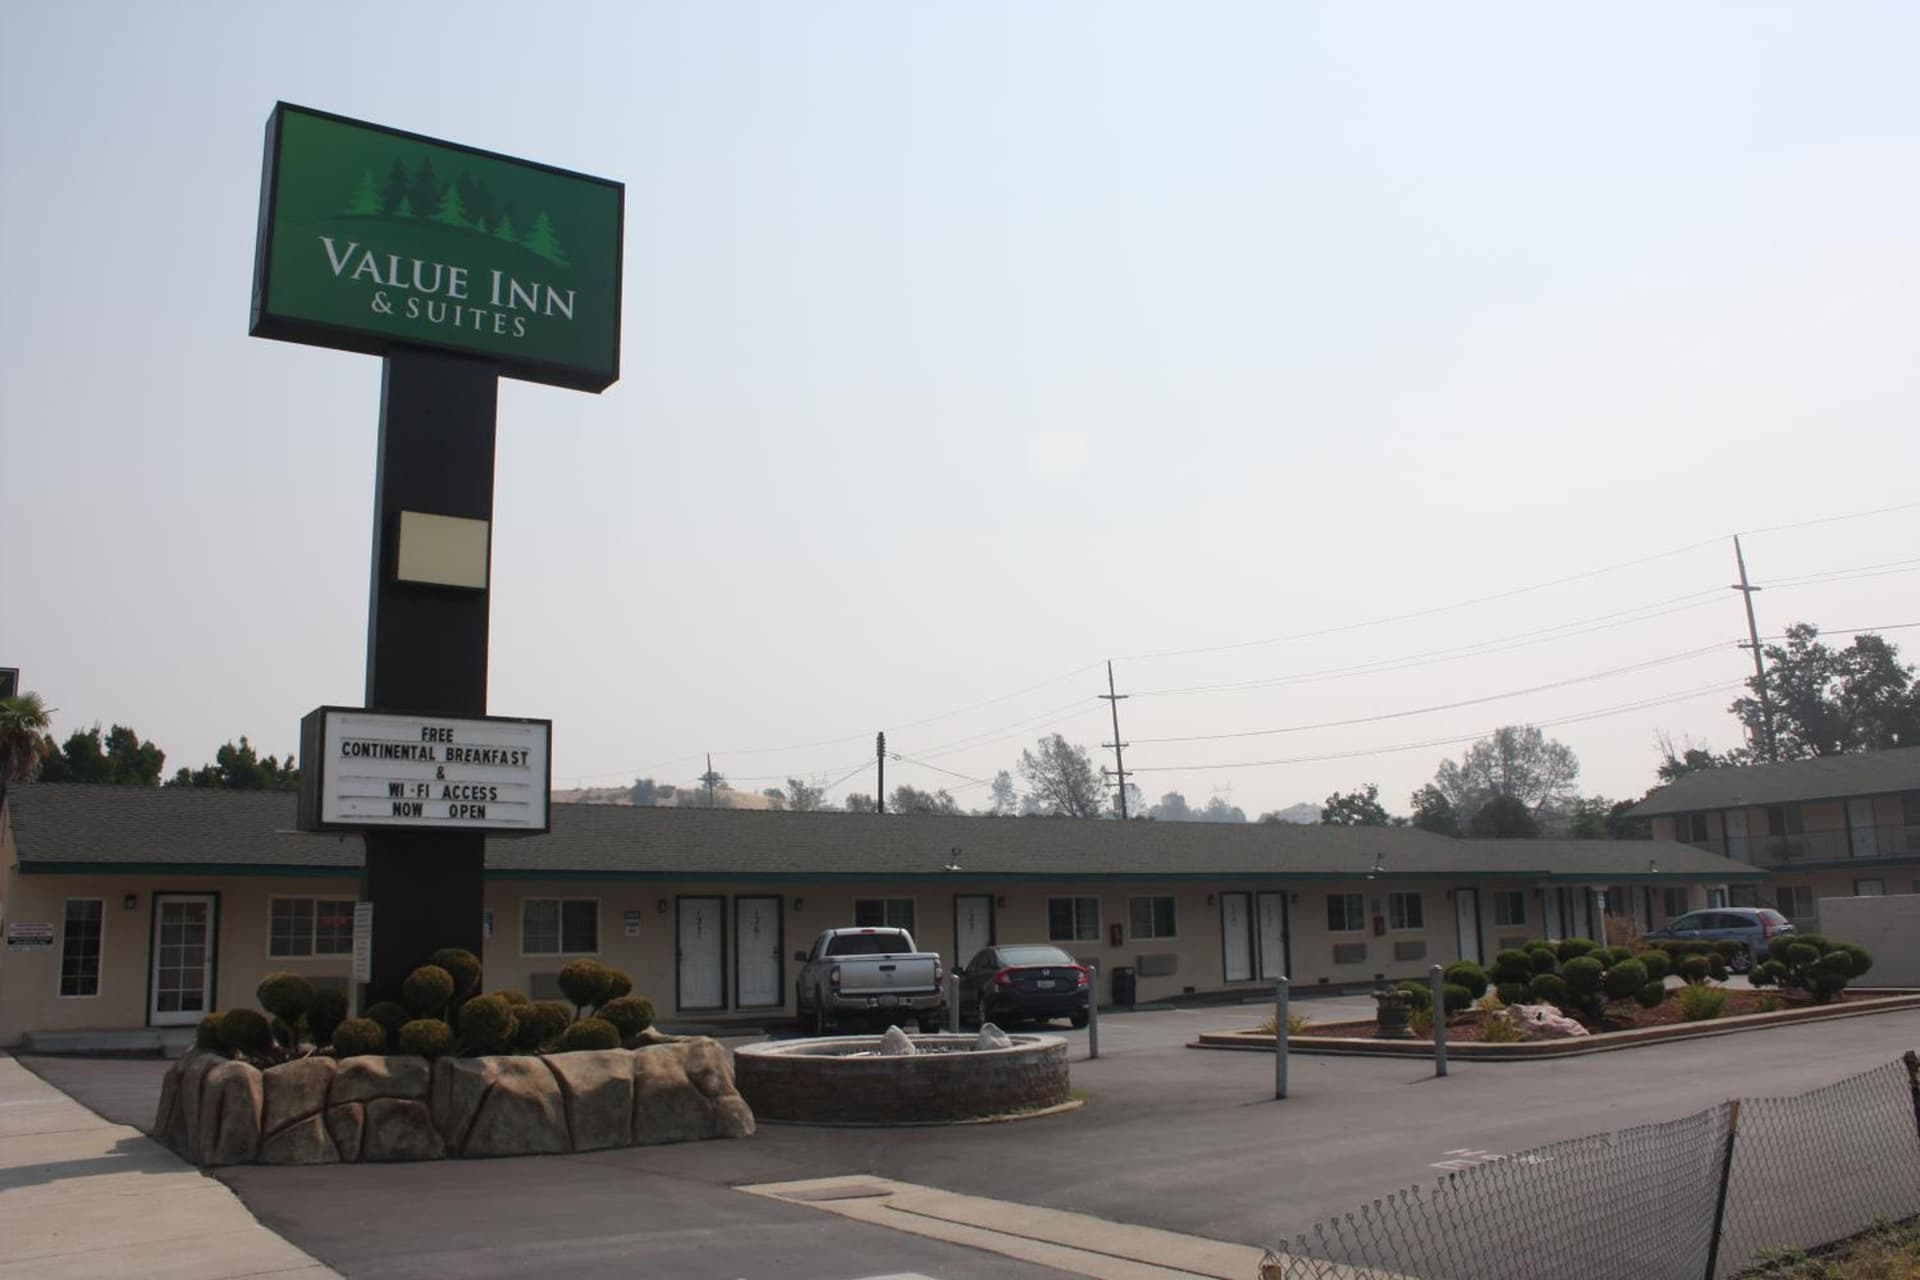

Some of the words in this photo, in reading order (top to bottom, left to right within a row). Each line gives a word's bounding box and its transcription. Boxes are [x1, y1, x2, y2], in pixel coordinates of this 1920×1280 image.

[319, 236, 469, 299] VALUE
[489, 270, 577, 320] INN
[371, 290, 394, 314] &
[406, 297, 527, 338] SUITES
[421, 727, 454, 743] FREE
[341, 741, 436, 761] CONTINENTAL
[445, 747, 529, 765] BREAKFAST
[436, 766, 445, 780] &
[442, 785, 498, 801] ACCESS
[392, 802, 423, 817] NOW
[449, 803, 486, 819] OPEN
